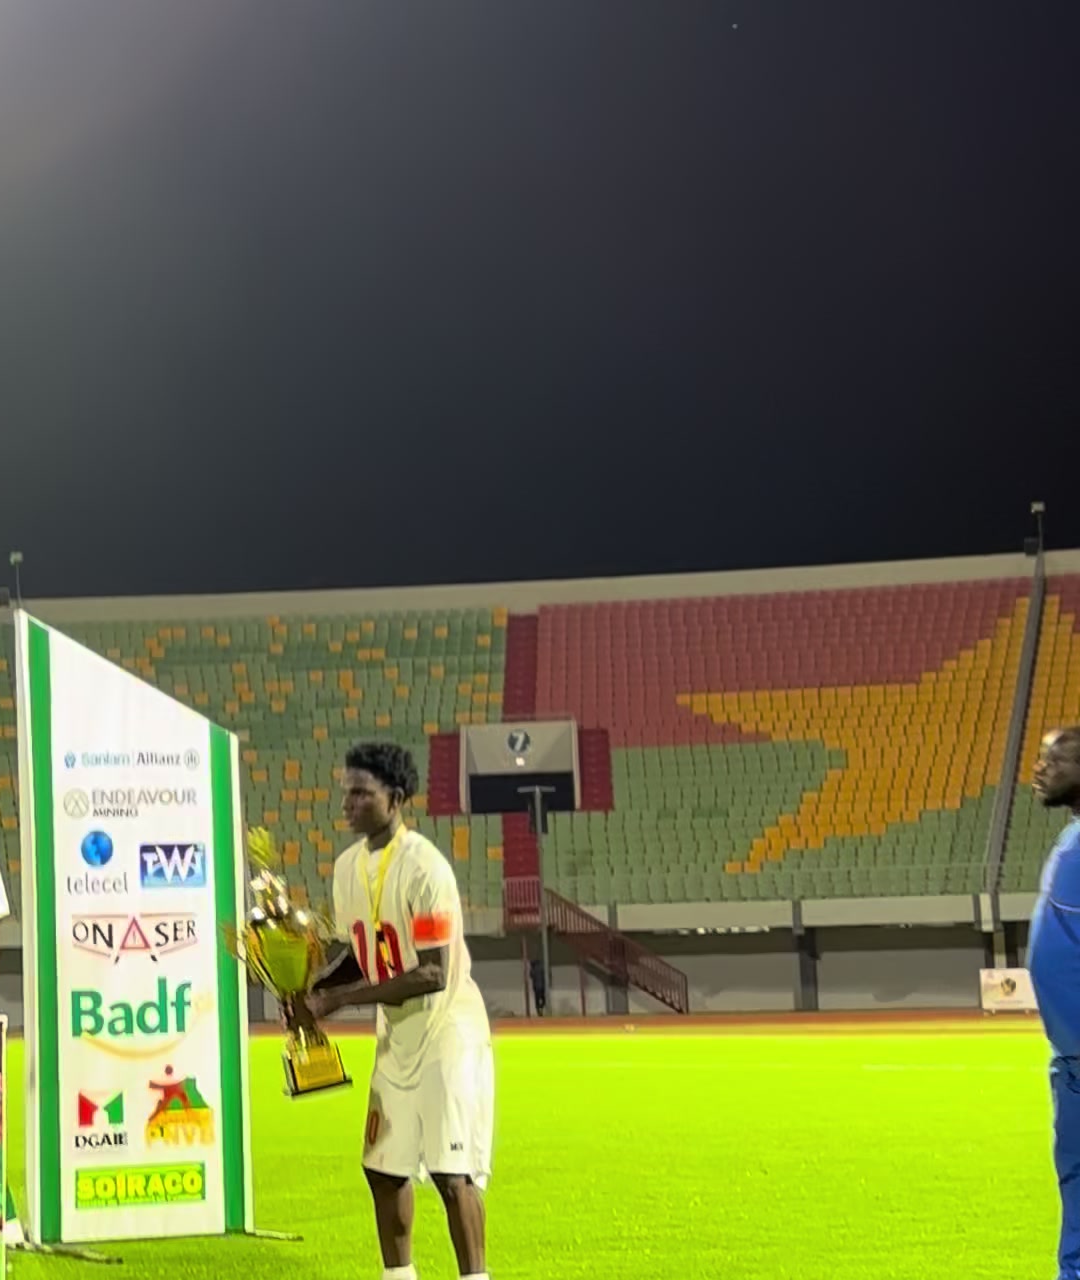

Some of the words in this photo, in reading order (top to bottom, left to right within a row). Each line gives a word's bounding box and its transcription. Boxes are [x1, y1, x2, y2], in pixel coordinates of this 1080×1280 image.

[136, 751, 181, 766] Allianz
[92, 788, 197, 806] ENDEAVOUR
[92, 809, 138, 817] MINING
[67, 872, 128, 895] telecel
[71, 976, 192, 1037] Badf
